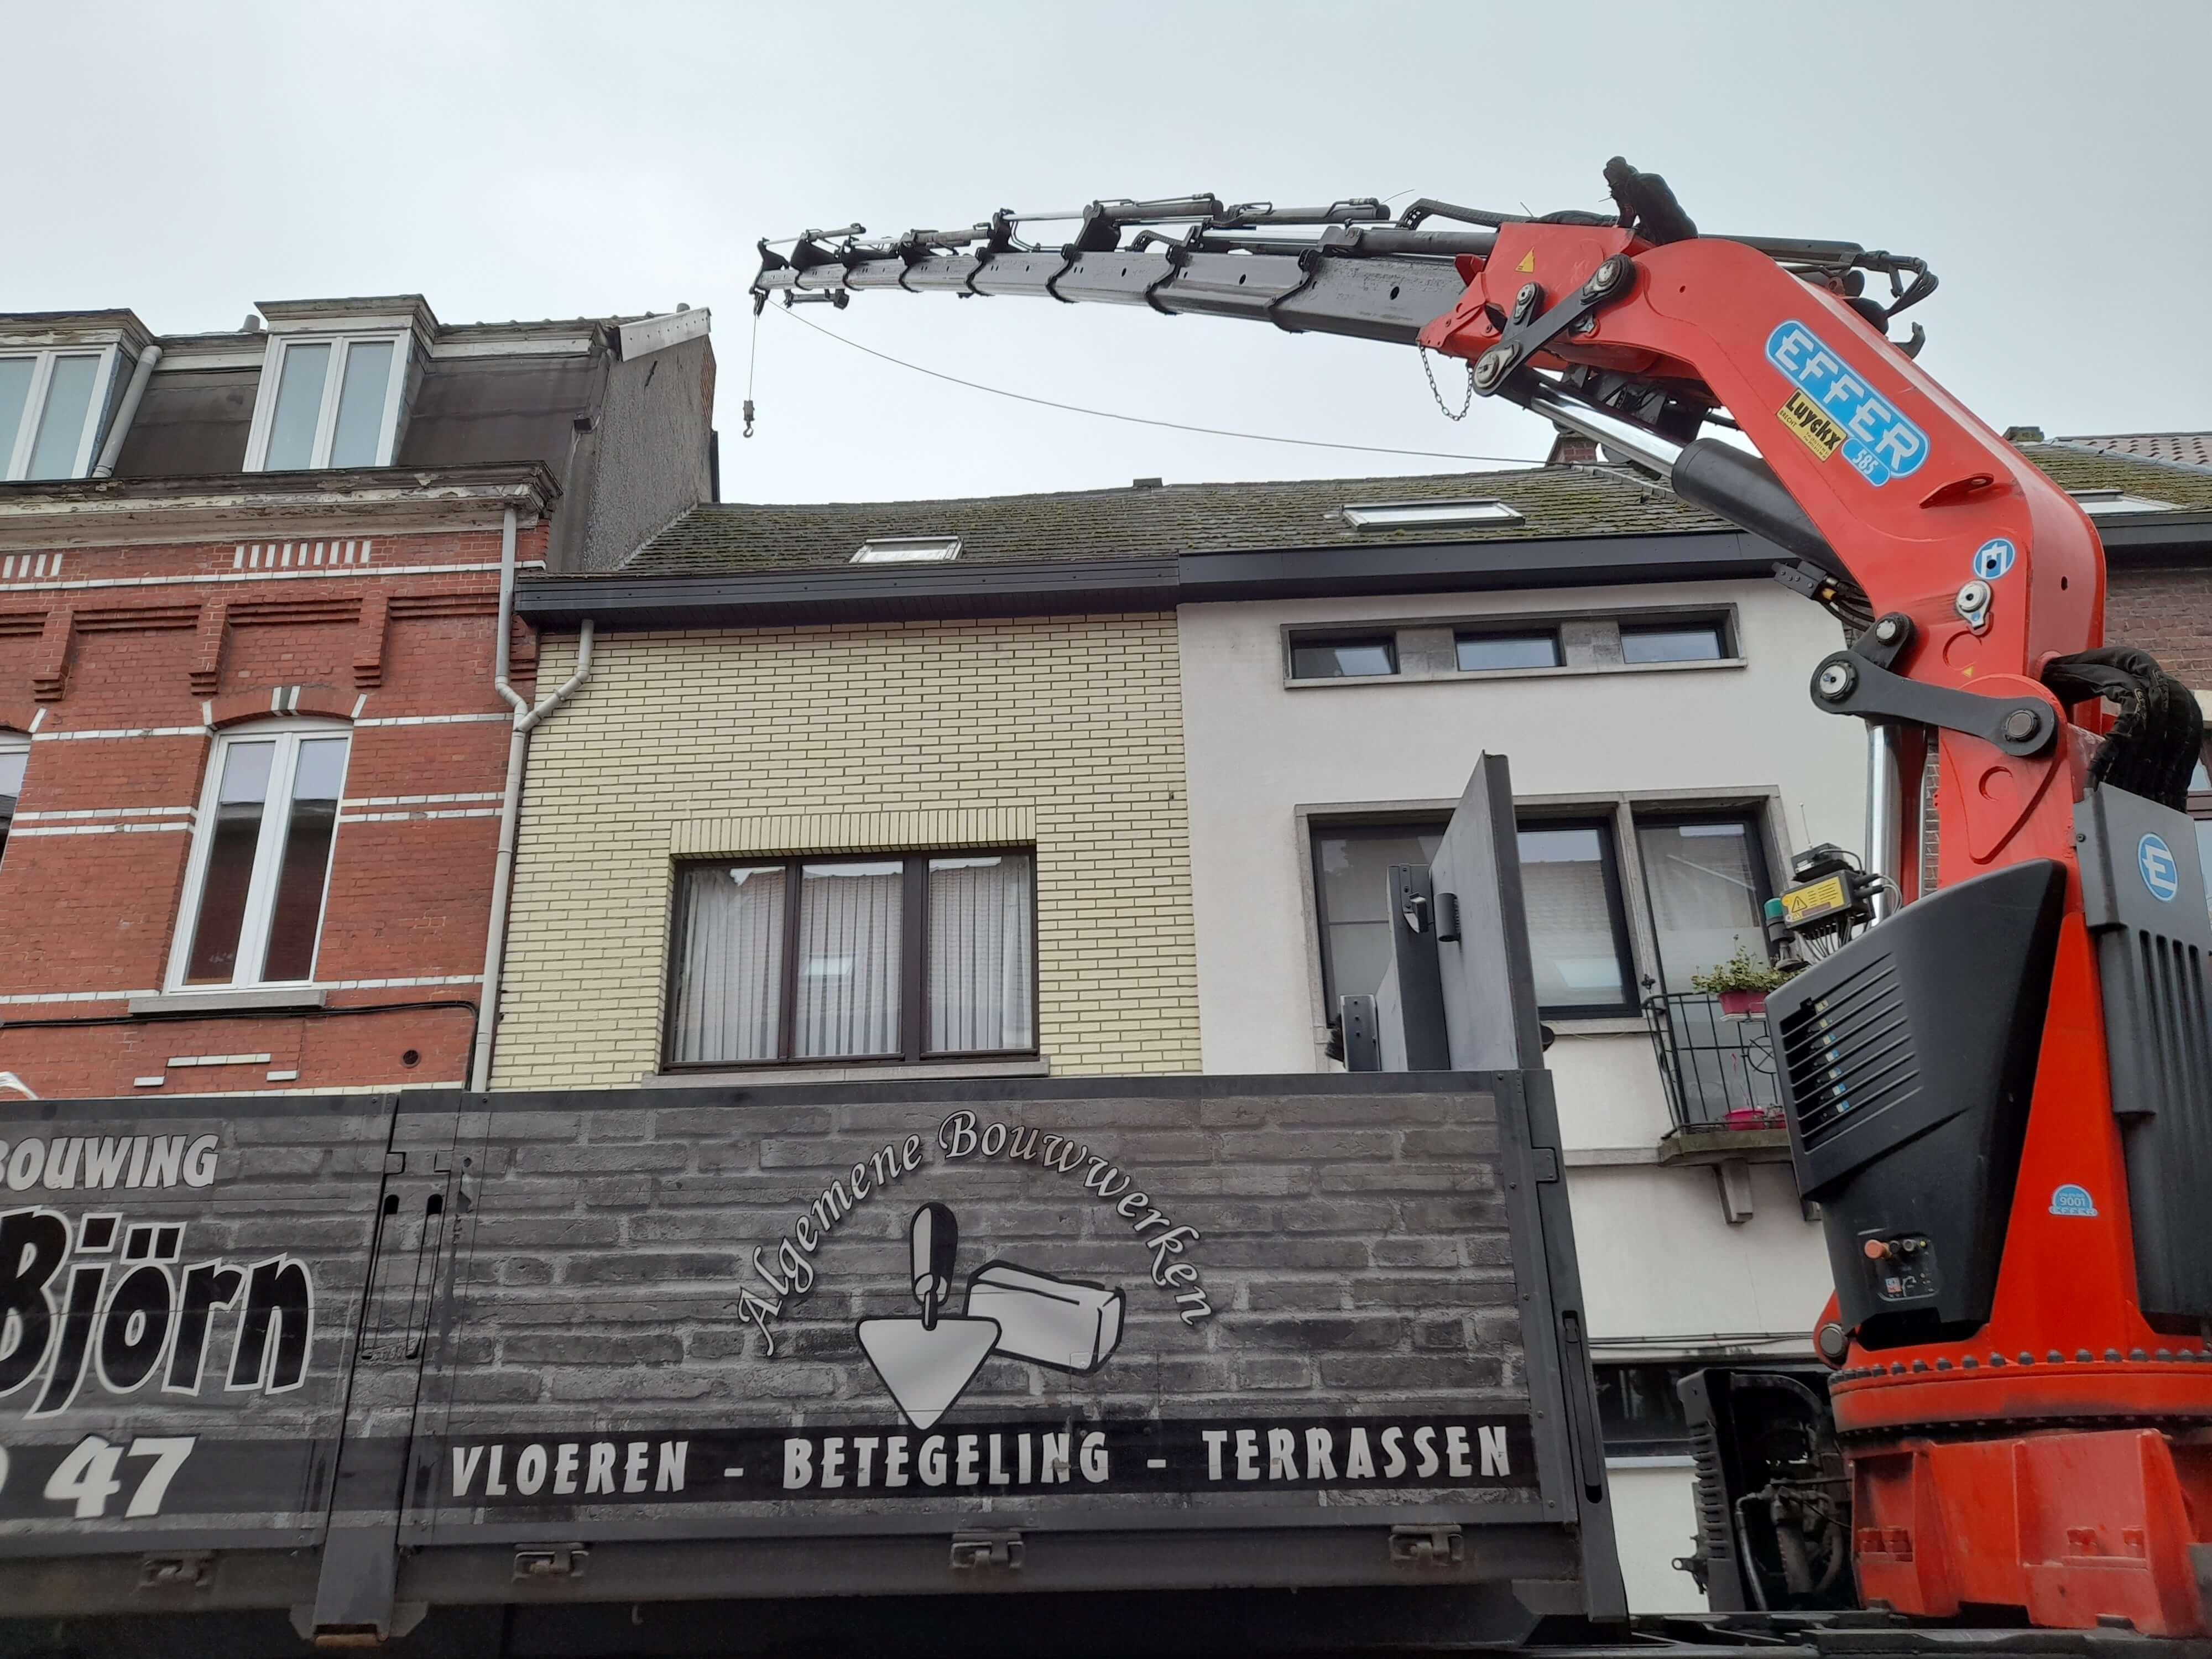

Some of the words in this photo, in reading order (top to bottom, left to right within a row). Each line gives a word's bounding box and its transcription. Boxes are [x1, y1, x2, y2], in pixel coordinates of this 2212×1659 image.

[1775, 329, 1918, 469] EFFER
[1779, 410, 1797, 428] BRECHT
[1786, 392, 1841, 451] Luyckx
[1853, 449, 1879, 475] 585
[0, 1133, 220, 1191] OUWING
[738, 1133, 923, 1357] Algemene
[937, 1109, 1212, 1326] Bouwwerken
[2060, 1196, 2085, 1207] 9001
[0, 1206, 314, 1420] Björn
[44, 1434, 199, 1519] 47
[452, 1441, 689, 1497] VLOEREN
[782, 1431, 1109, 1489] BETEGELING
[1202, 1425, 1511, 1481] TERRASSEN
